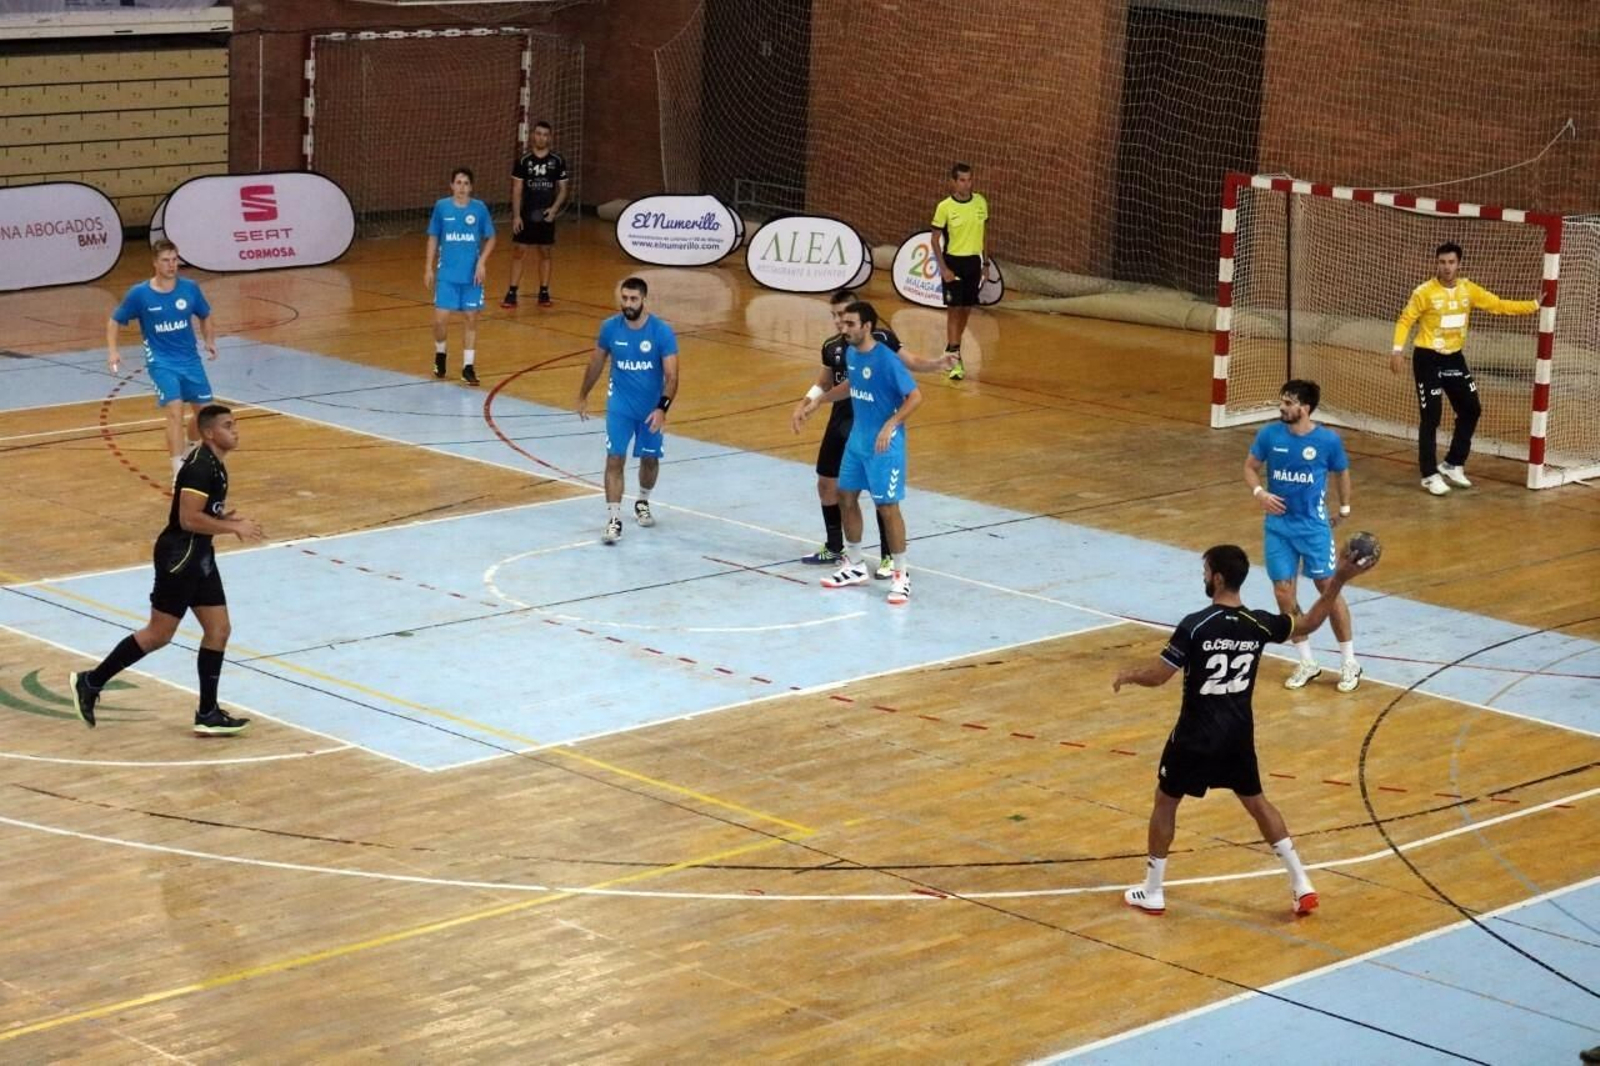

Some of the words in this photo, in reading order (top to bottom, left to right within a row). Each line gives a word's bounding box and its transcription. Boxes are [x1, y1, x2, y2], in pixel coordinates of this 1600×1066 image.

[25, 216, 104, 238] ABOGADOS
[631, 211, 651, 229] El
[652, 212, 721, 231] Numerillo
[233, 227, 293, 242] SEAT
[632, 240, 720, 250] www.elnumerillo.com
[761, 231, 848, 265] ALEA
[239, 247, 296, 260] CORMOSA
[617, 359, 653, 371] MÁLAGA
[1273, 469, 1314, 484] MÁLAGA
[1199, 653, 1255, 695] 22
